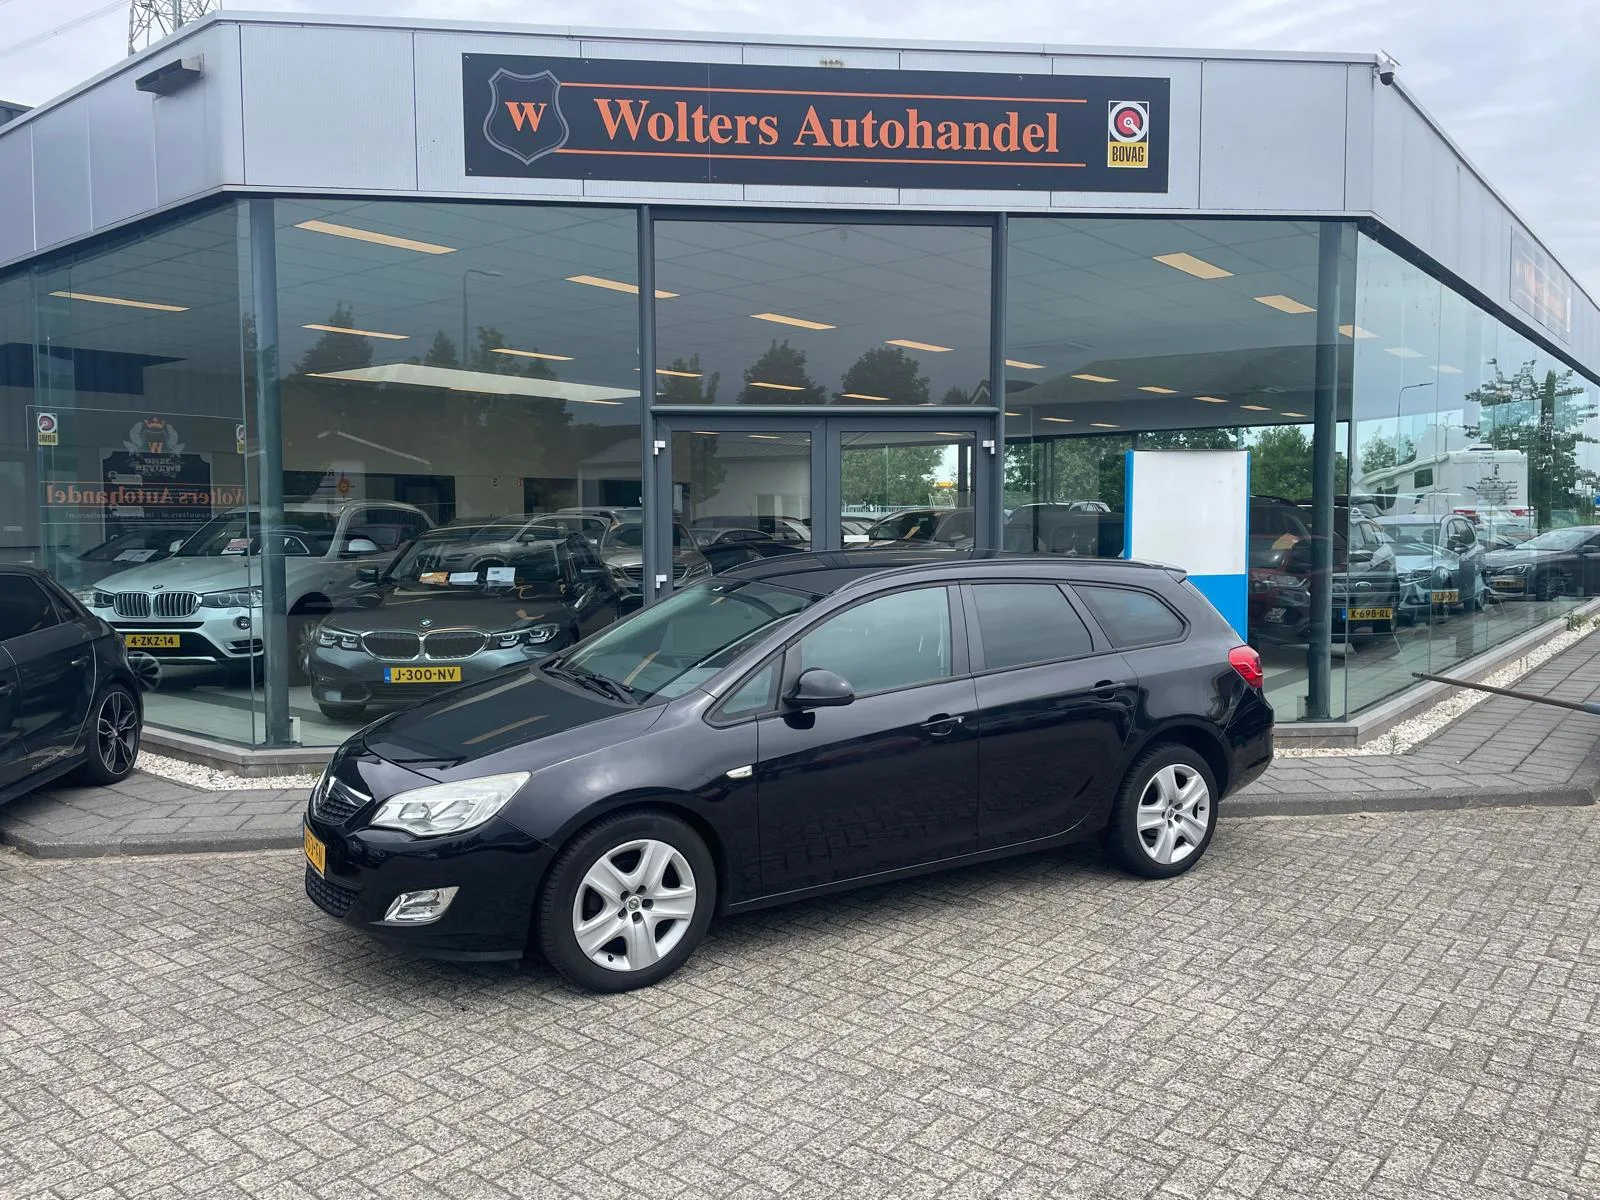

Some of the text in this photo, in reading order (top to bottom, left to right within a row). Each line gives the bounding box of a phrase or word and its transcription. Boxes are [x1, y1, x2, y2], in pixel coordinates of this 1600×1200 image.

[504, 101, 547, 132] W
[593, 98, 1060, 154] Wolters Autohandel
[1112, 146, 1144, 163] BOVAG
[1350, 609, 1391, 618] K-698-RL
[131, 636, 175, 646] 4-ZKZ-14
[395, 668, 455, 681] J-300-NV
